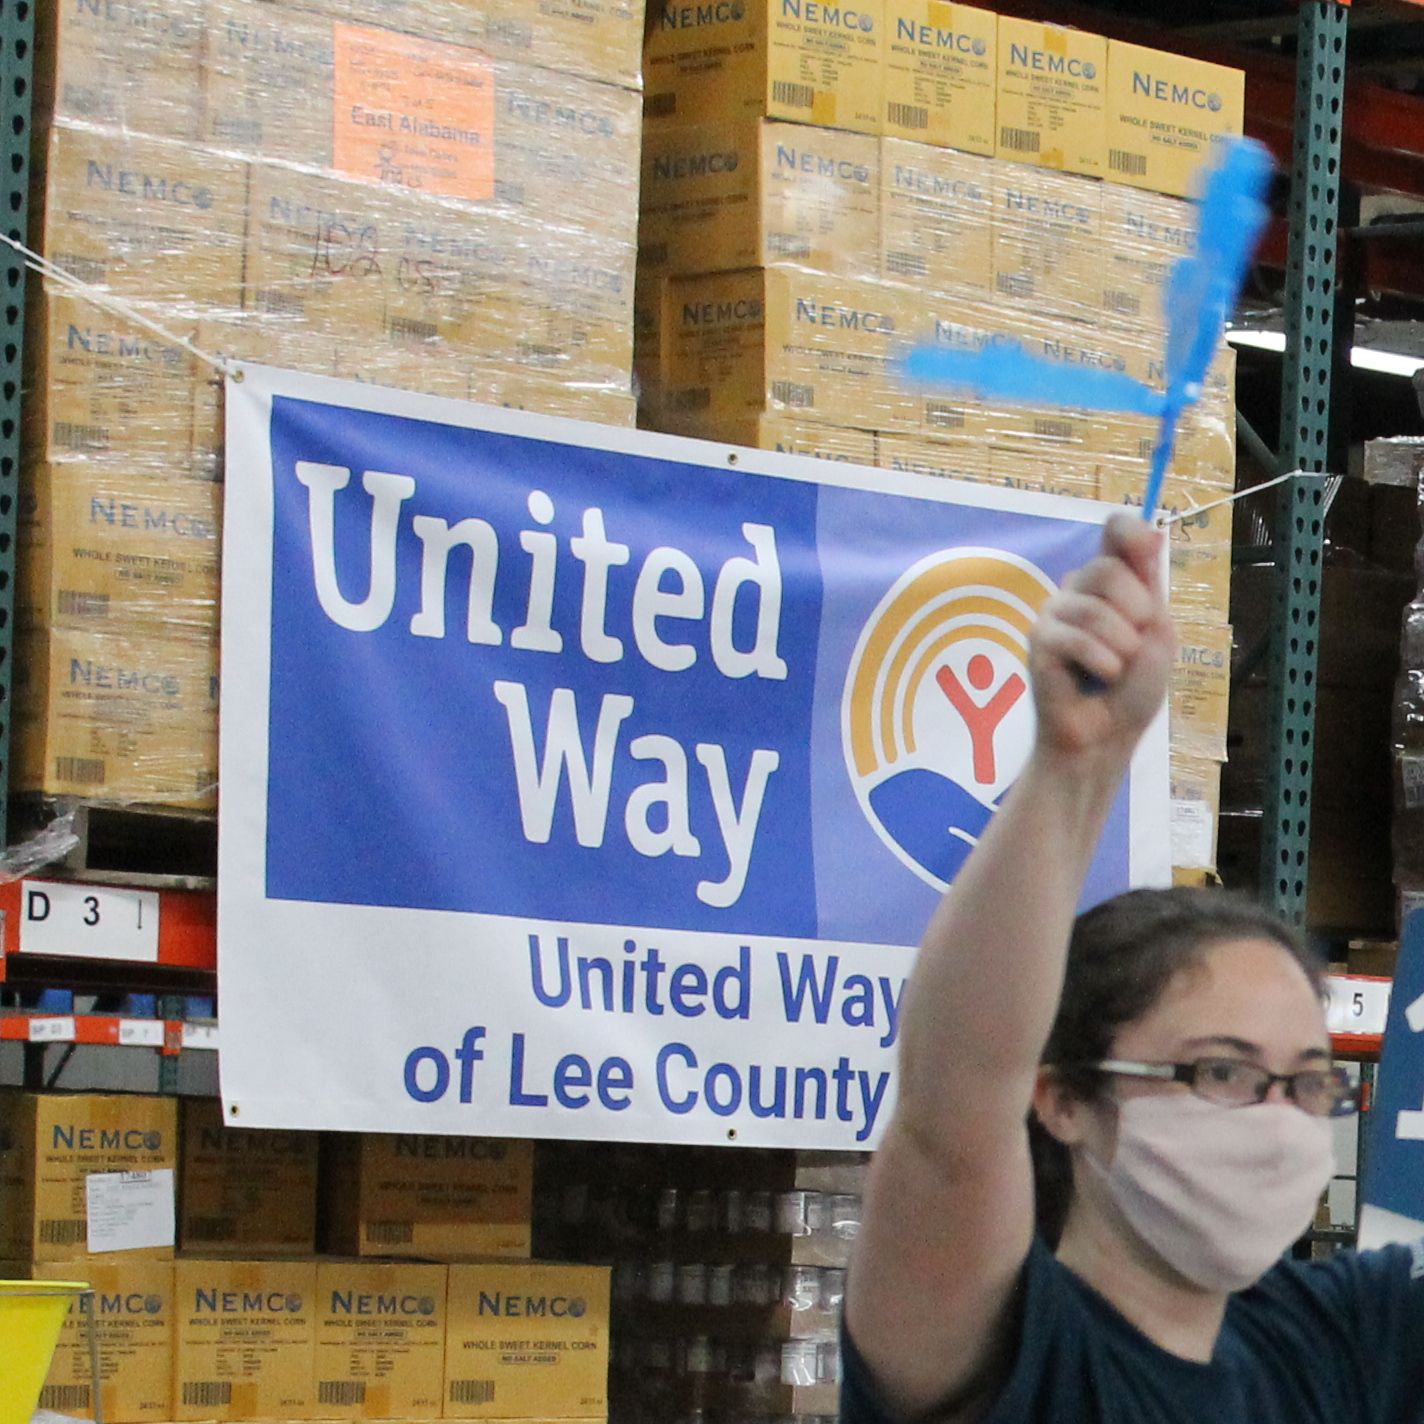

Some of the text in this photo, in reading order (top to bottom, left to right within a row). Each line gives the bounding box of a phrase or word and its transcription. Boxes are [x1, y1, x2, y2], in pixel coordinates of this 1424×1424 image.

[783, 0, 873, 32] NEMCO
[897, 17, 986, 56] NEMCO
[1011, 43, 1096, 80] NEMCO
[1133, 70, 1222, 112] NEMCO
[400, 115, 482, 145] Alabama
[1120, 115, 1207, 142] WHOLE SWEET KERNEL
[777, 145, 868, 182] NEMCO
[88, 160, 214, 209] NEMCO
[683, 300, 764, 325] NEMCO
[797, 298, 895, 334] NEMCO
[90, 497, 216, 538] NEMCO
[73, 548, 150, 565] WHOLE SWEET
[295, 461, 788, 680] United
[70, 658, 180, 695] NEMCO
[493, 681, 779, 908] Way
[27, 890, 100, 926] D 3
[528, 934, 907, 1049] United Way
[1352, 993, 1363, 1016] 5
[404, 1025, 890, 1142] of Lee County
[53, 1124, 161, 1151] NEMCO
[66, 1294, 163, 1314] EMCO
[195, 1287, 303, 1314] NEMCO
[331, 1290, 435, 1316] NEMCO
[478, 1290, 587, 1318] NEMCO
[189, 1317, 306, 1327] WHOLE SWEET KERNEL CORN
[323, 1319, 415, 1328] WHOLE KERNEL
[463, 1340, 597, 1351] WHOLE SWEET KERNEL CORN
